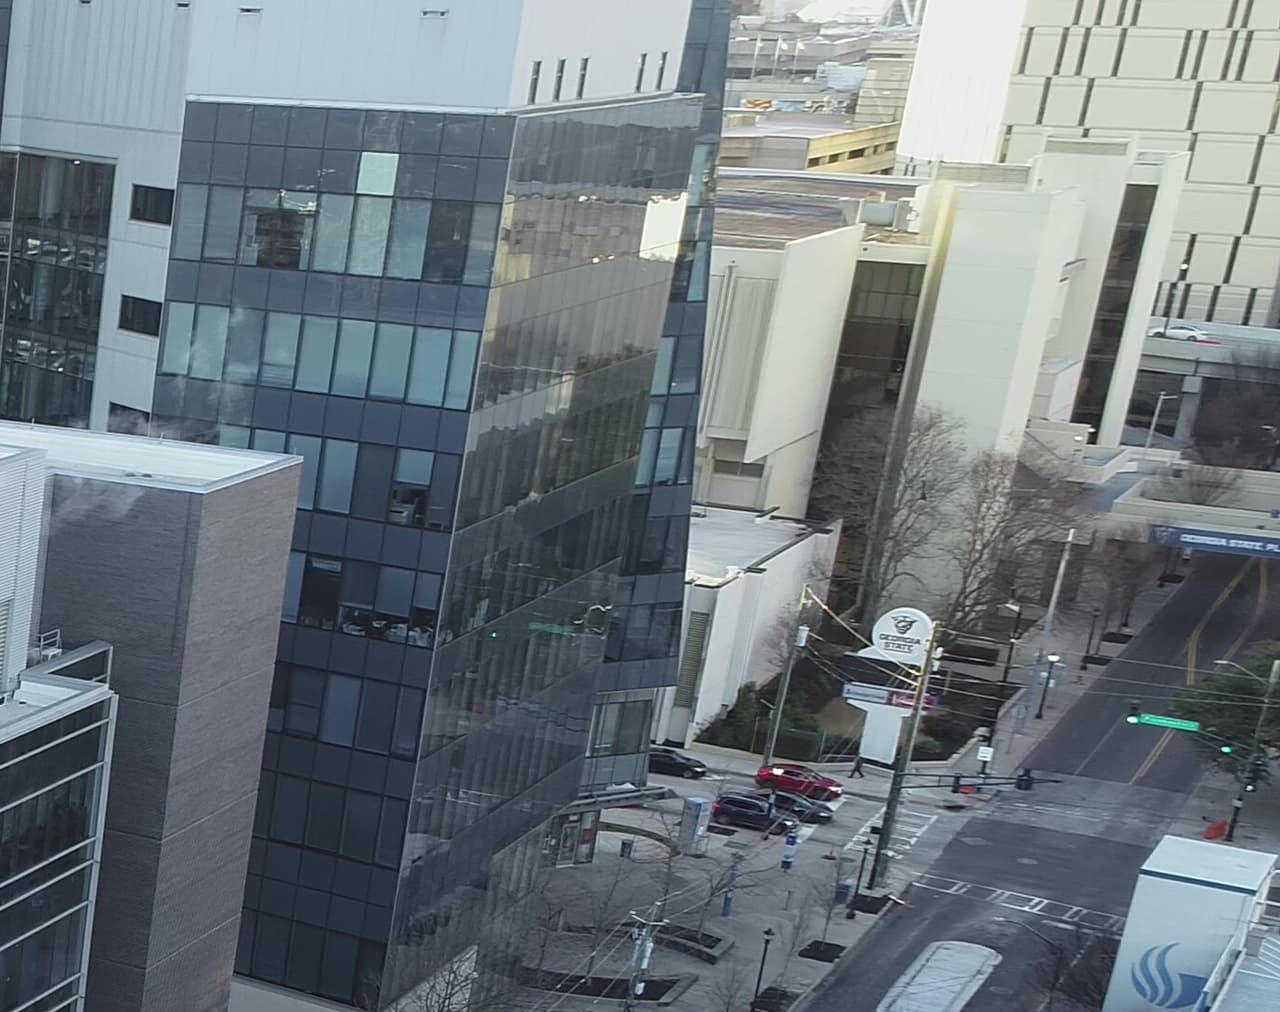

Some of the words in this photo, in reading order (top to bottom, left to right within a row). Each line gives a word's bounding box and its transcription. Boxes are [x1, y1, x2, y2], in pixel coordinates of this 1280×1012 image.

[1179, 534, 1227, 546] GEORGIA
[1228, 539, 1264, 550] STATE
[879, 633, 921, 644] GEORGIA
[884, 642, 914, 651] STATE
